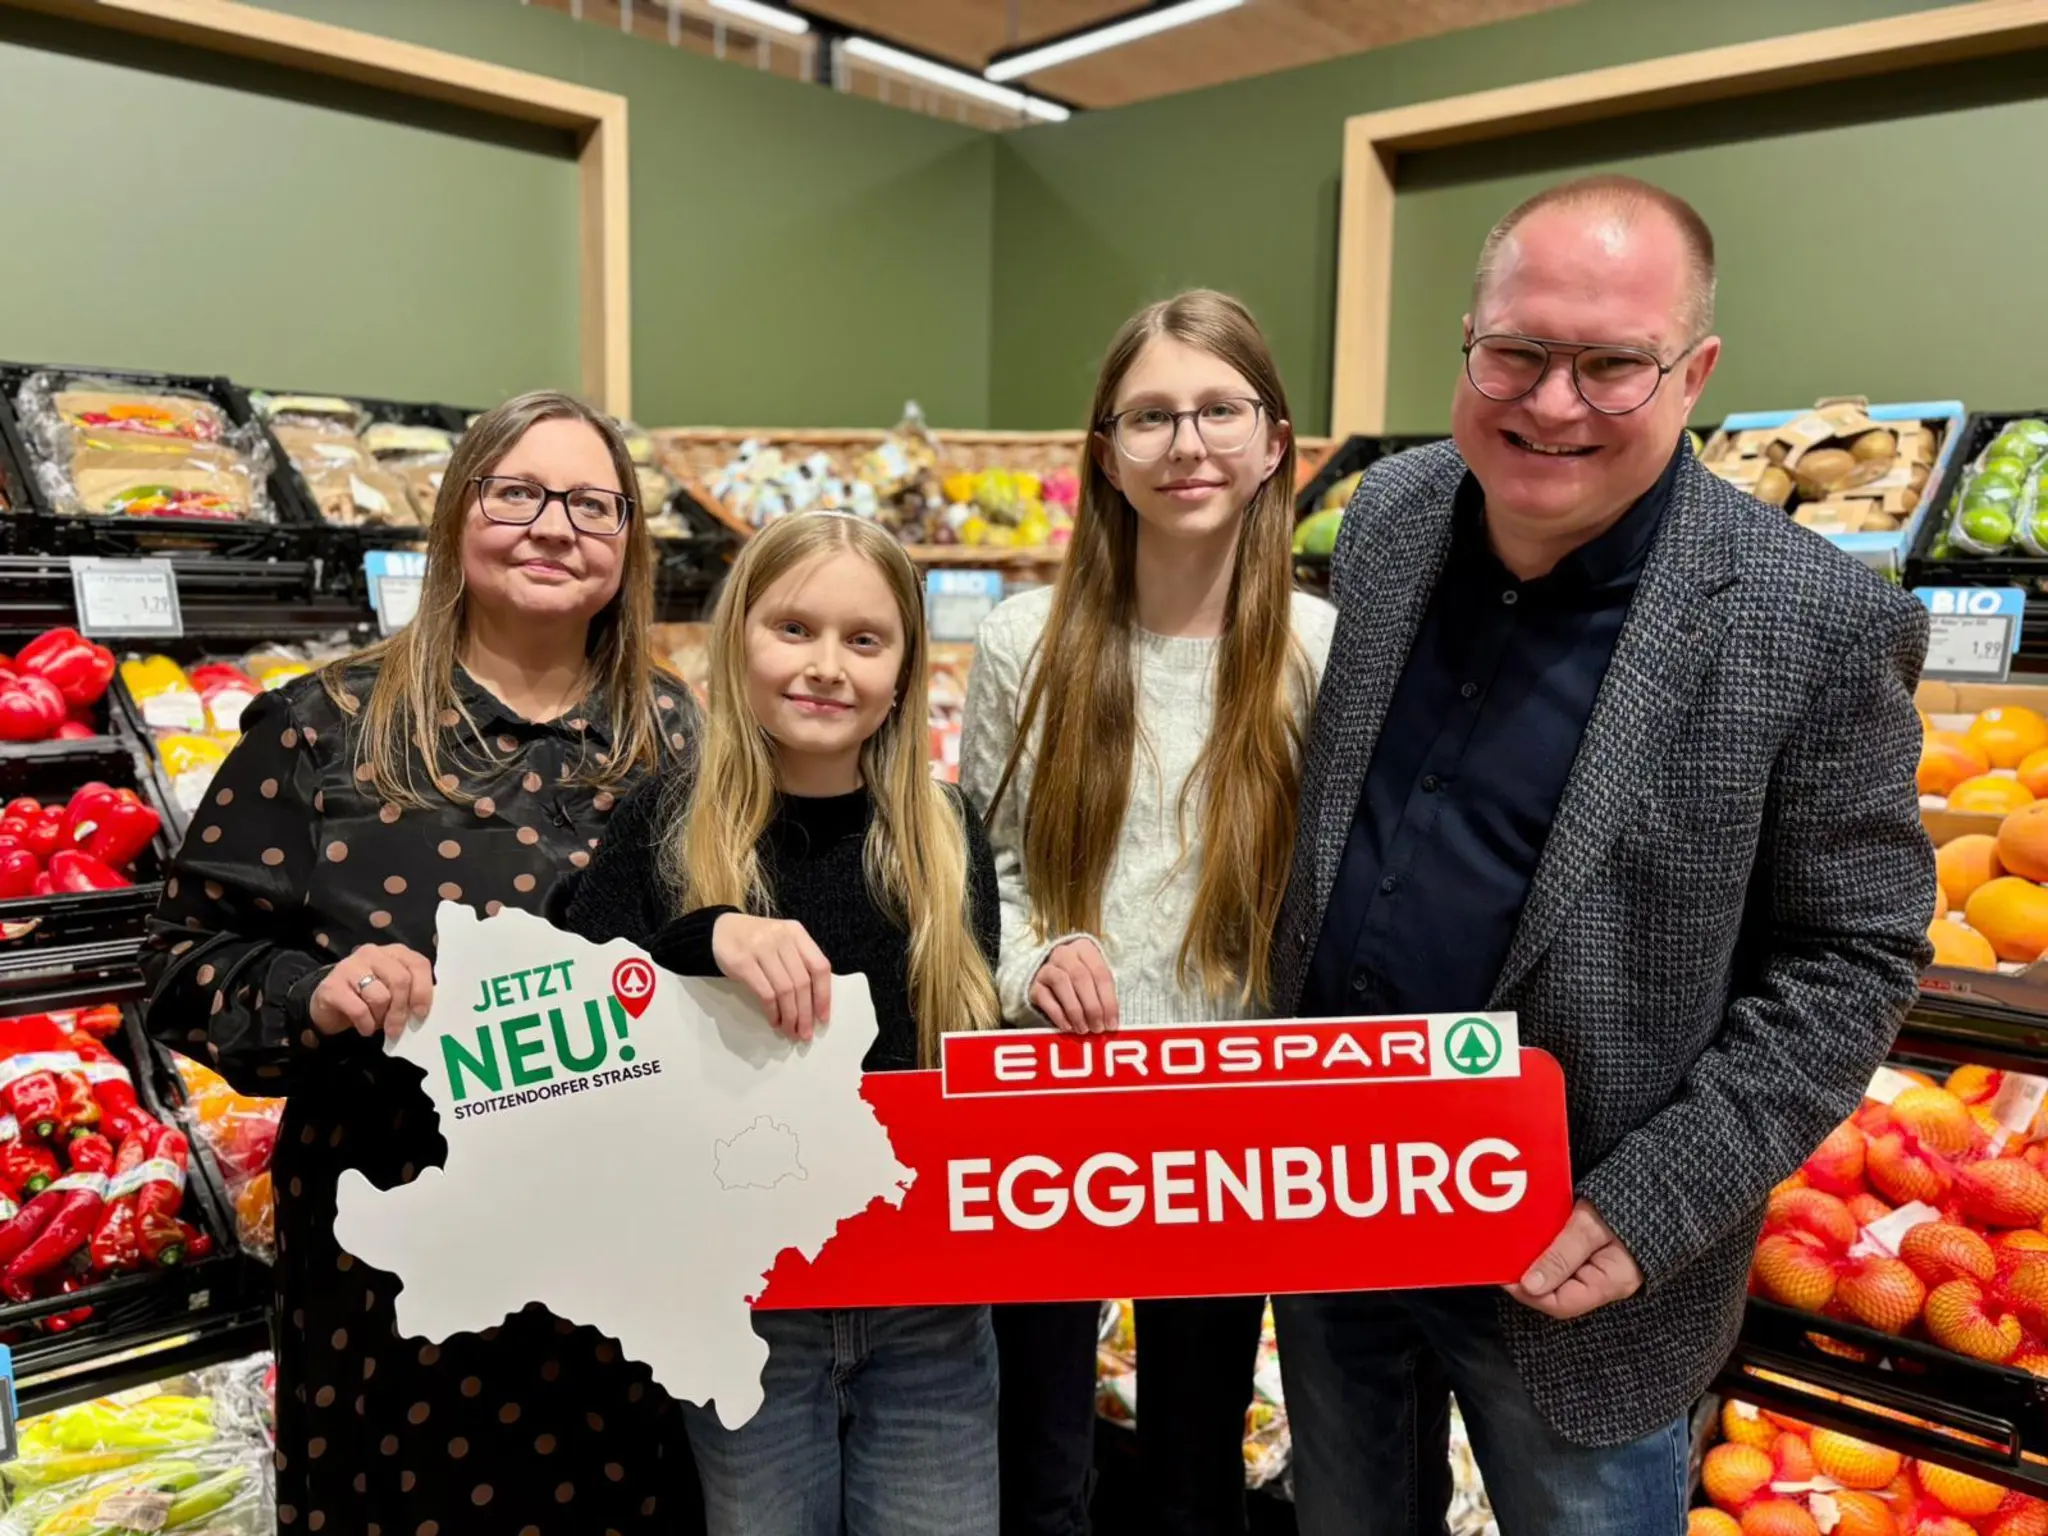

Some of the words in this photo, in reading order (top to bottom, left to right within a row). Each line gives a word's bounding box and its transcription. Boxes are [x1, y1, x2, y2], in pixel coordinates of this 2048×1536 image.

[1931, 589, 2003, 615] BIO
[473, 959, 575, 1012] JETZT
[440, 994, 636, 1101] NEU!
[993, 1031, 1426, 1080] EUROSPAR
[454, 1077, 590, 1120] STOITZENDORFER
[592, 1060, 662, 1088] STRASSE
[947, 1138, 1528, 1232] EGGENBURG
